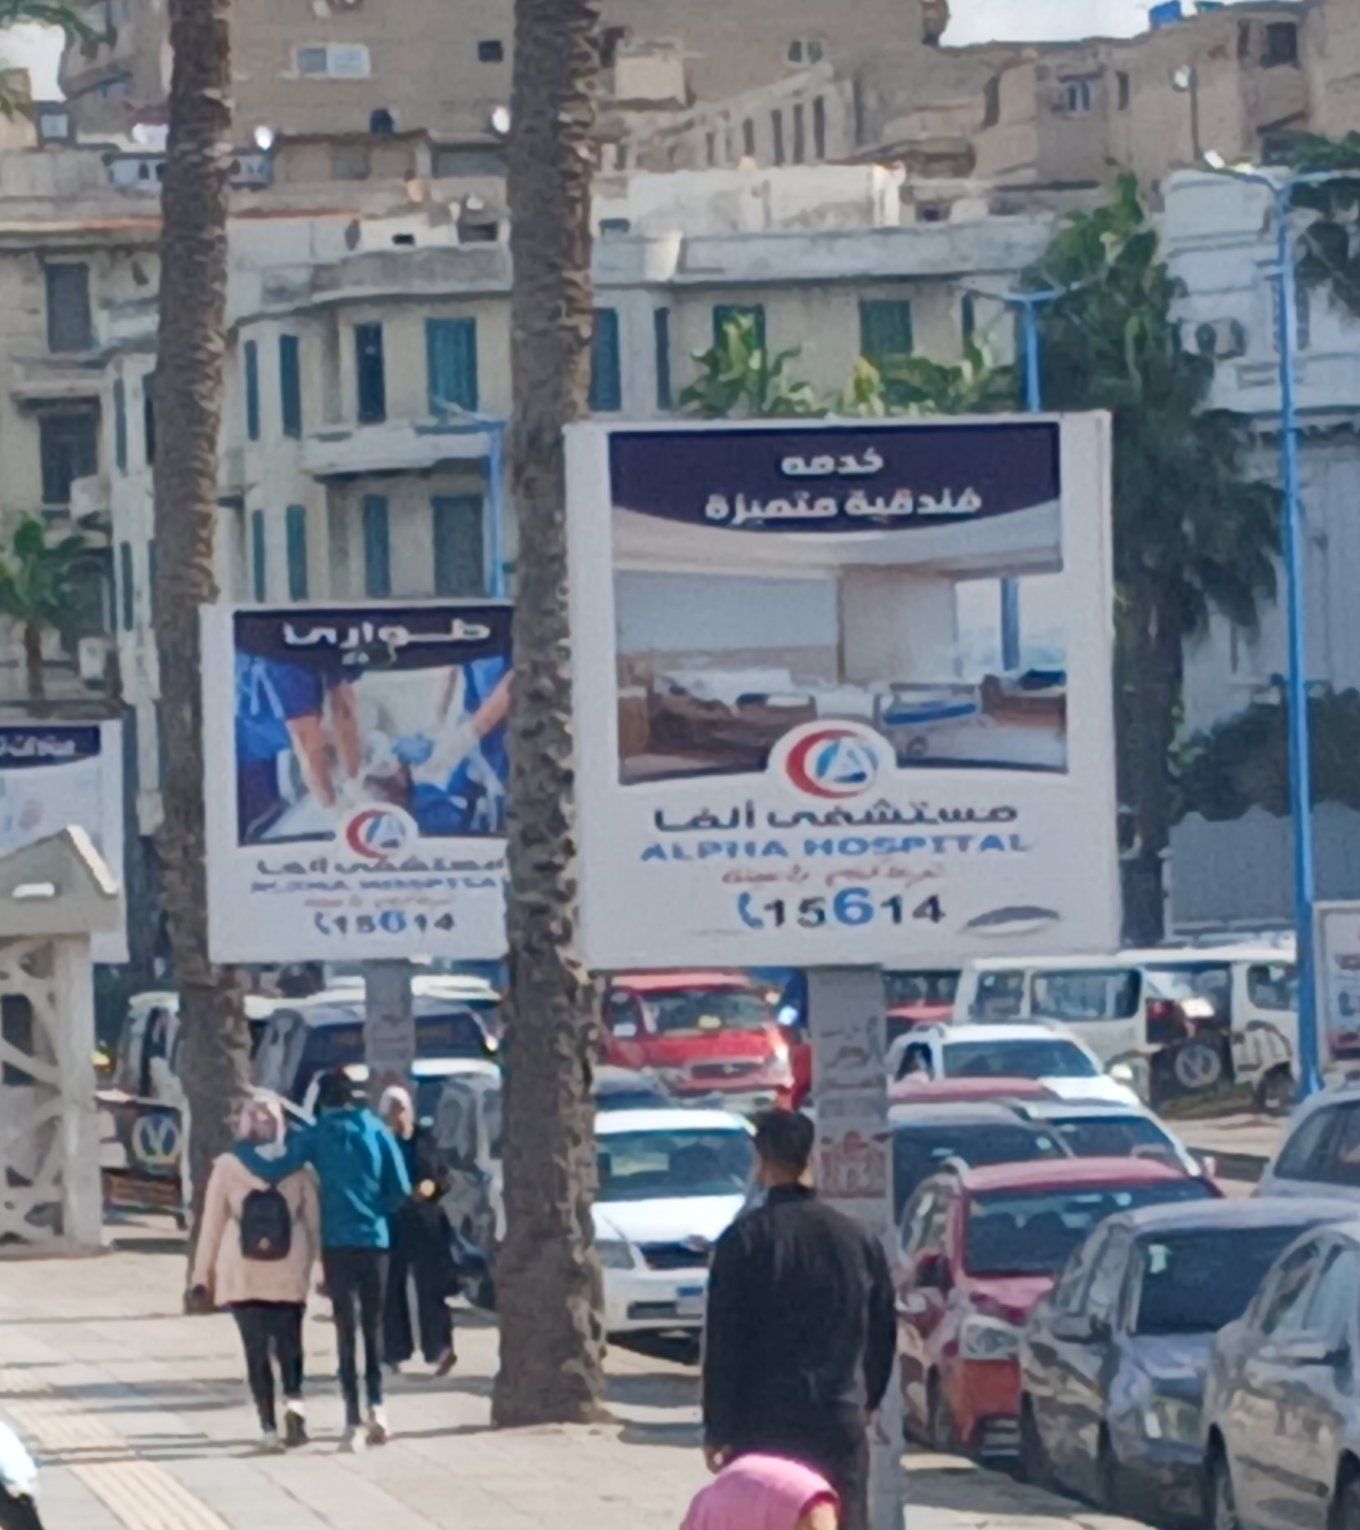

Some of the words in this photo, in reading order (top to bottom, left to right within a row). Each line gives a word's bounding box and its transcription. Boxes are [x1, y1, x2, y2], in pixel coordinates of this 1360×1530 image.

[640, 839, 789, 862] ALPHA
[803, 833, 1036, 857] HOSPITAL
[763, 886, 947, 929] 15614
